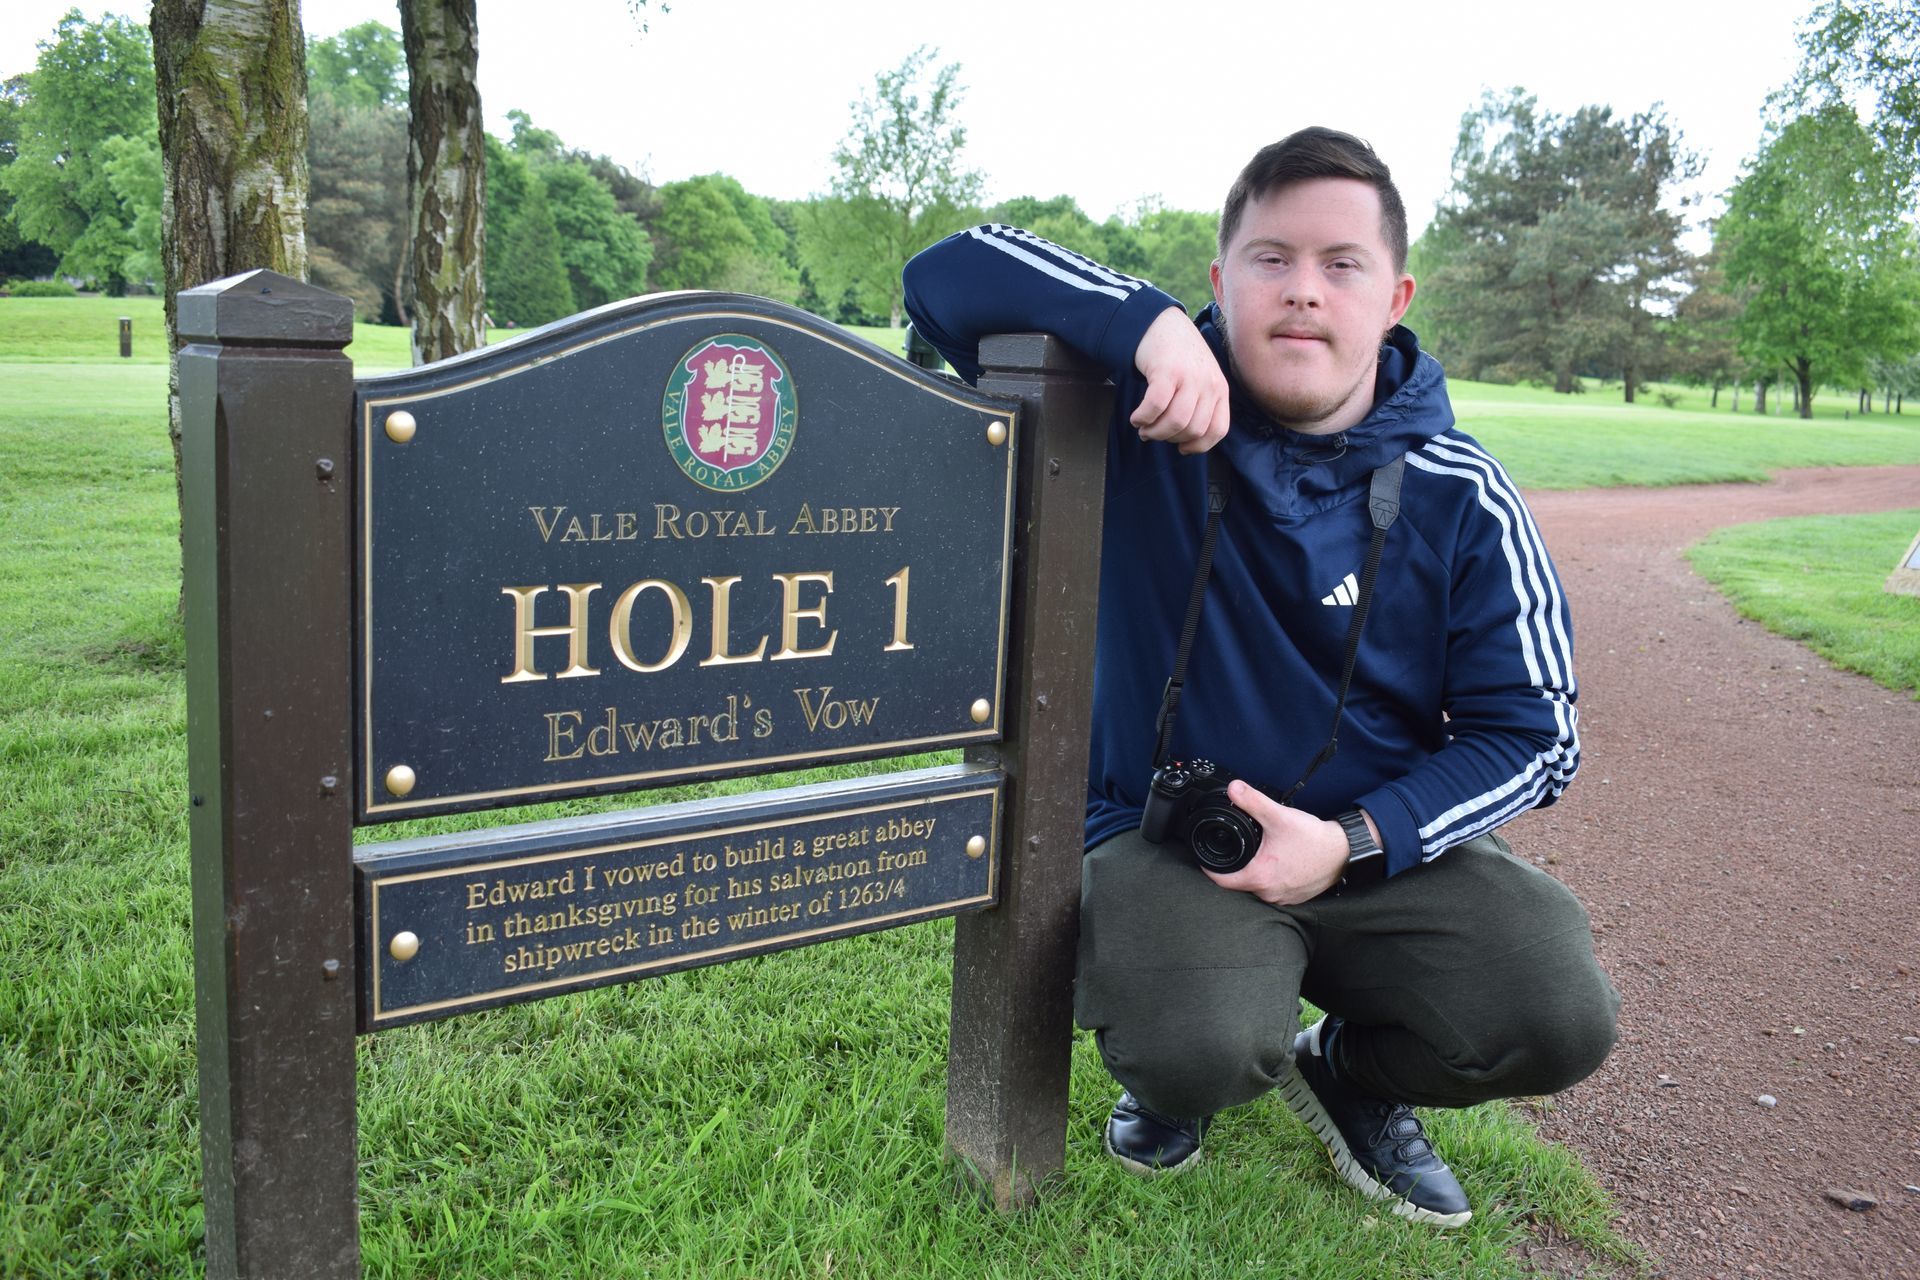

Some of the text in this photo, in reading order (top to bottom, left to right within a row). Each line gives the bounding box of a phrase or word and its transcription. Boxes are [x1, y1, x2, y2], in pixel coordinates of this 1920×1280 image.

[665, 391, 794, 487] VALE ROYAL ABBEY
[501, 566, 914, 683] HOLE 1
[543, 686, 880, 762] Edward's Vow
[466, 816, 936, 910] Edward I vowed to build a great abbey
[466, 847, 928, 945] in thanksgiving for his salvation from
[504, 876, 906, 973] shipwreck in the winter of 1263/4
